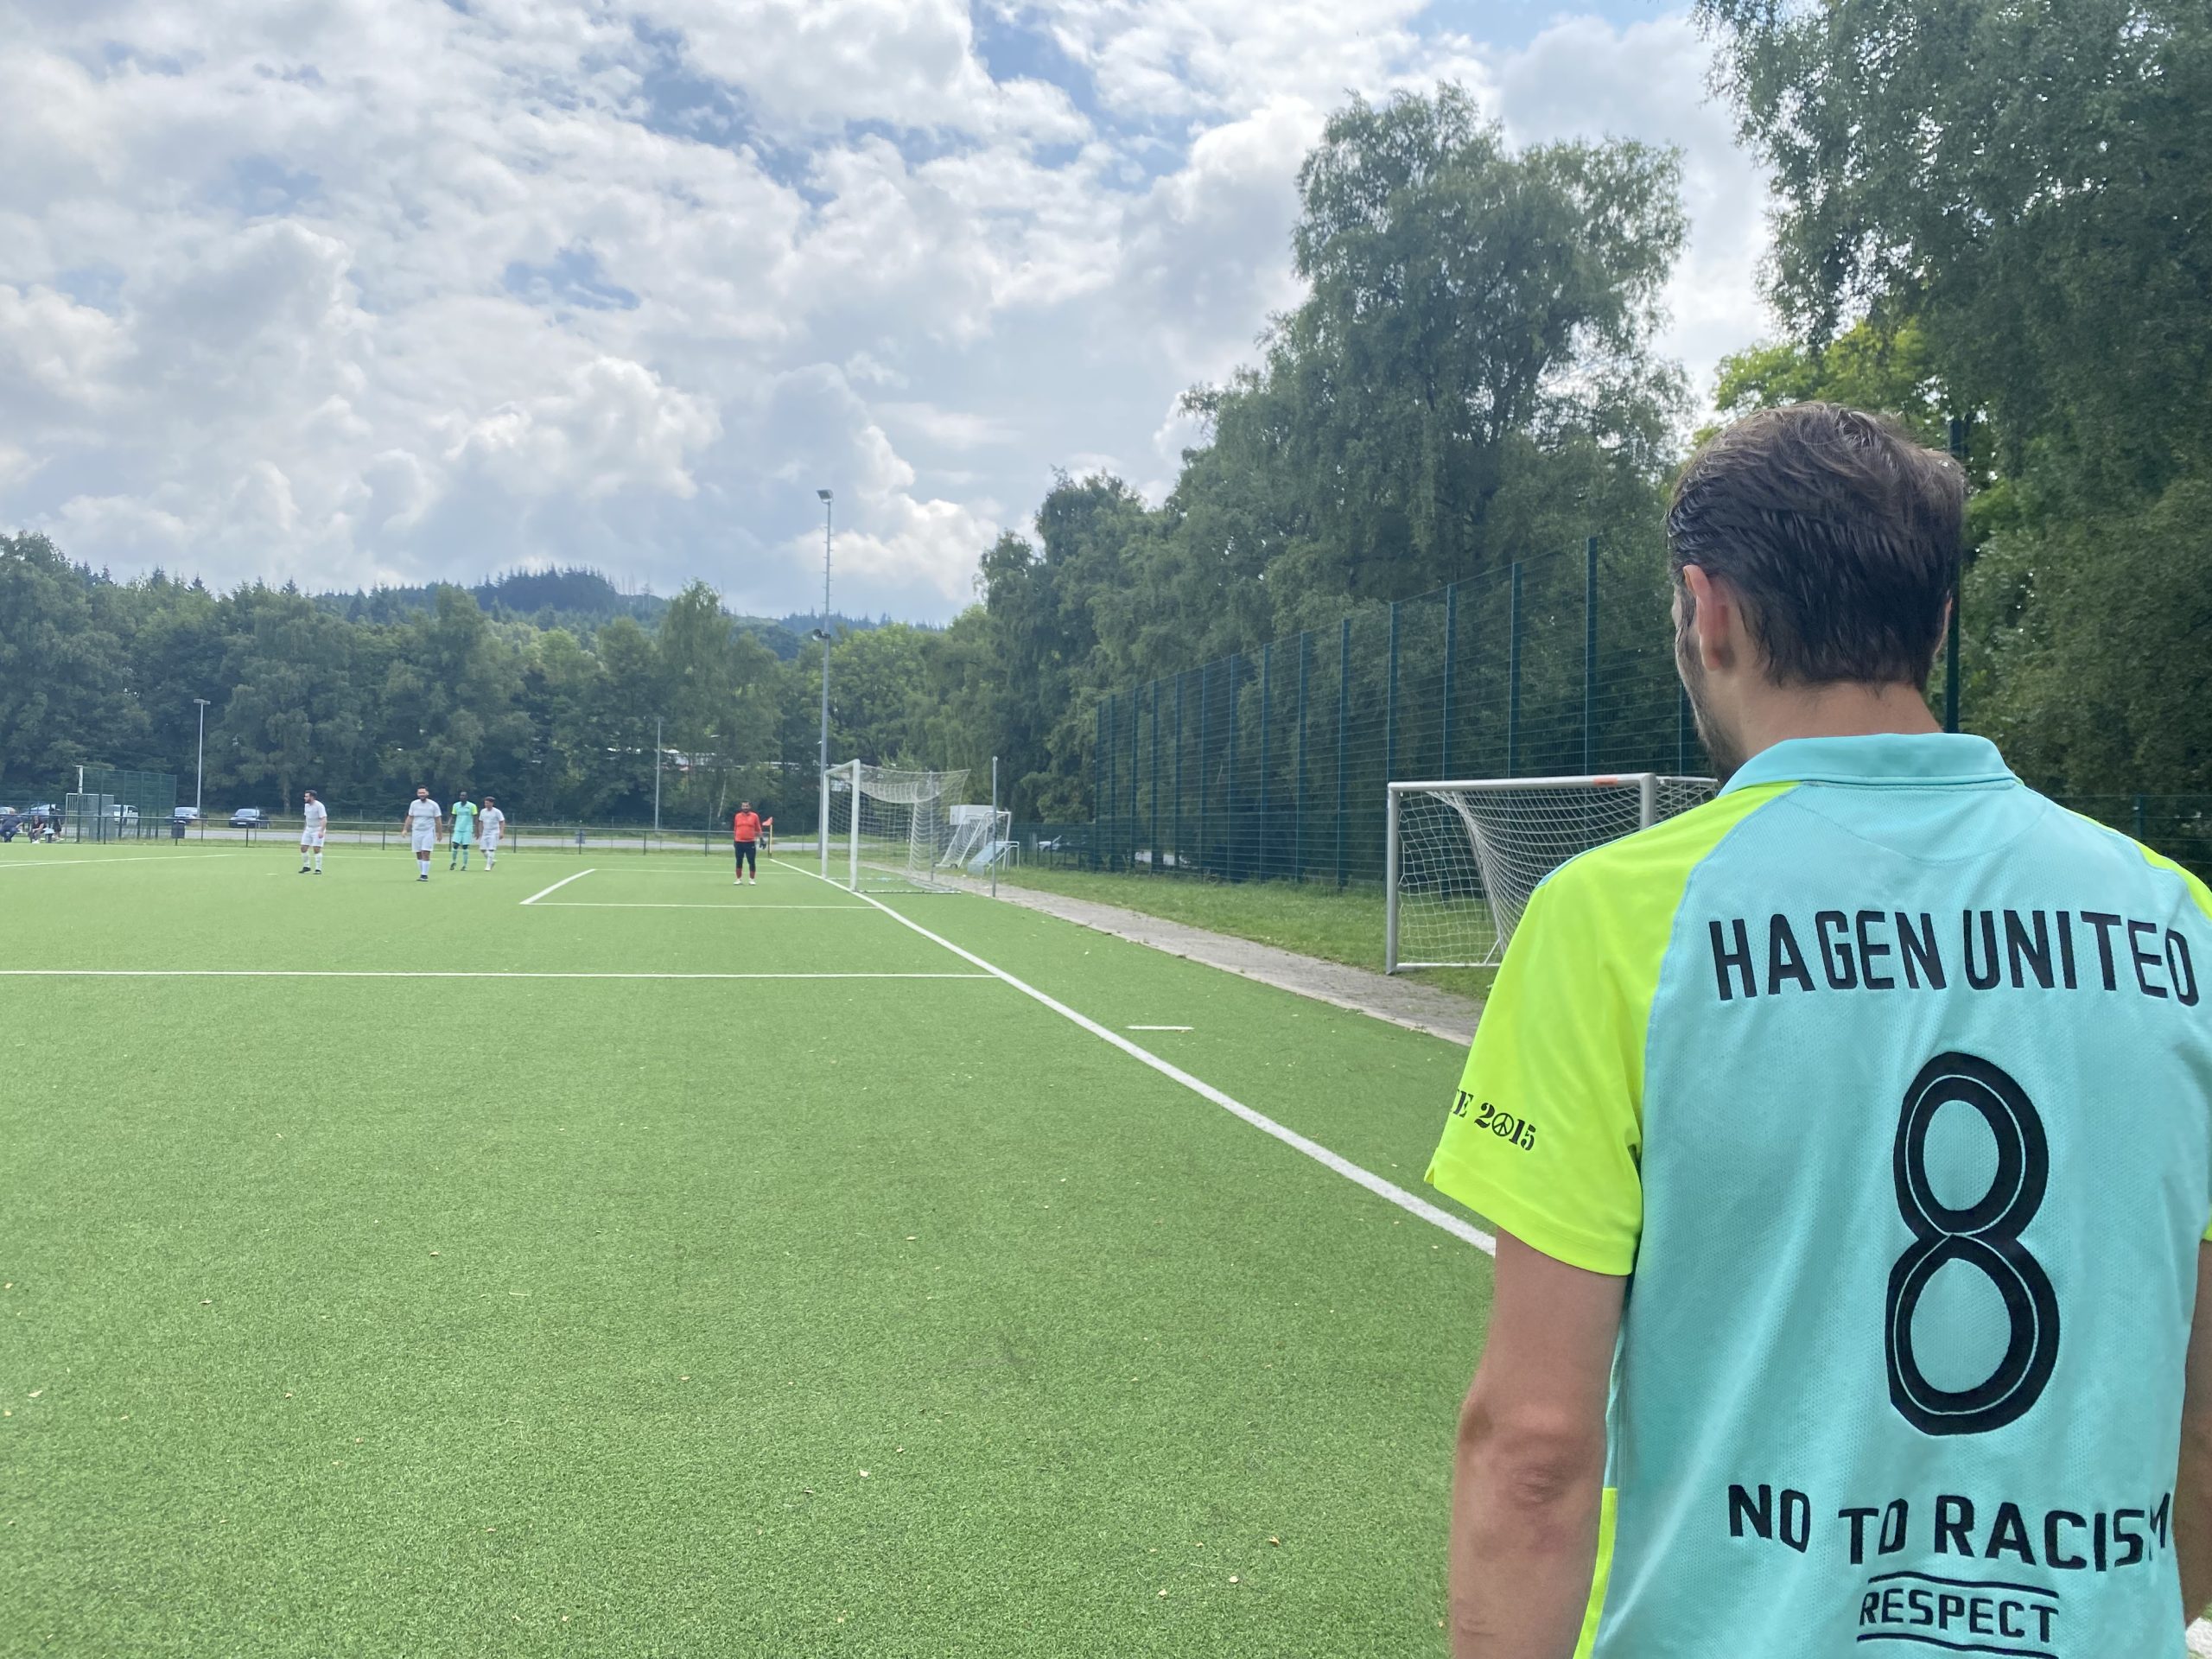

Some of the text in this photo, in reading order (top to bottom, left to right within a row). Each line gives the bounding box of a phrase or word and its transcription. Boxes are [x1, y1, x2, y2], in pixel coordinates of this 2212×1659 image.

[1709, 909, 2200, 1007] HAGEN UNITED
[1474, 1102, 1536, 1151] 2015
[1886, 1051, 2060, 1435] 8
[1729, 1484, 2171, 1572] NO TO RACISM
[1859, 1587, 2060, 1643] RESPECT
